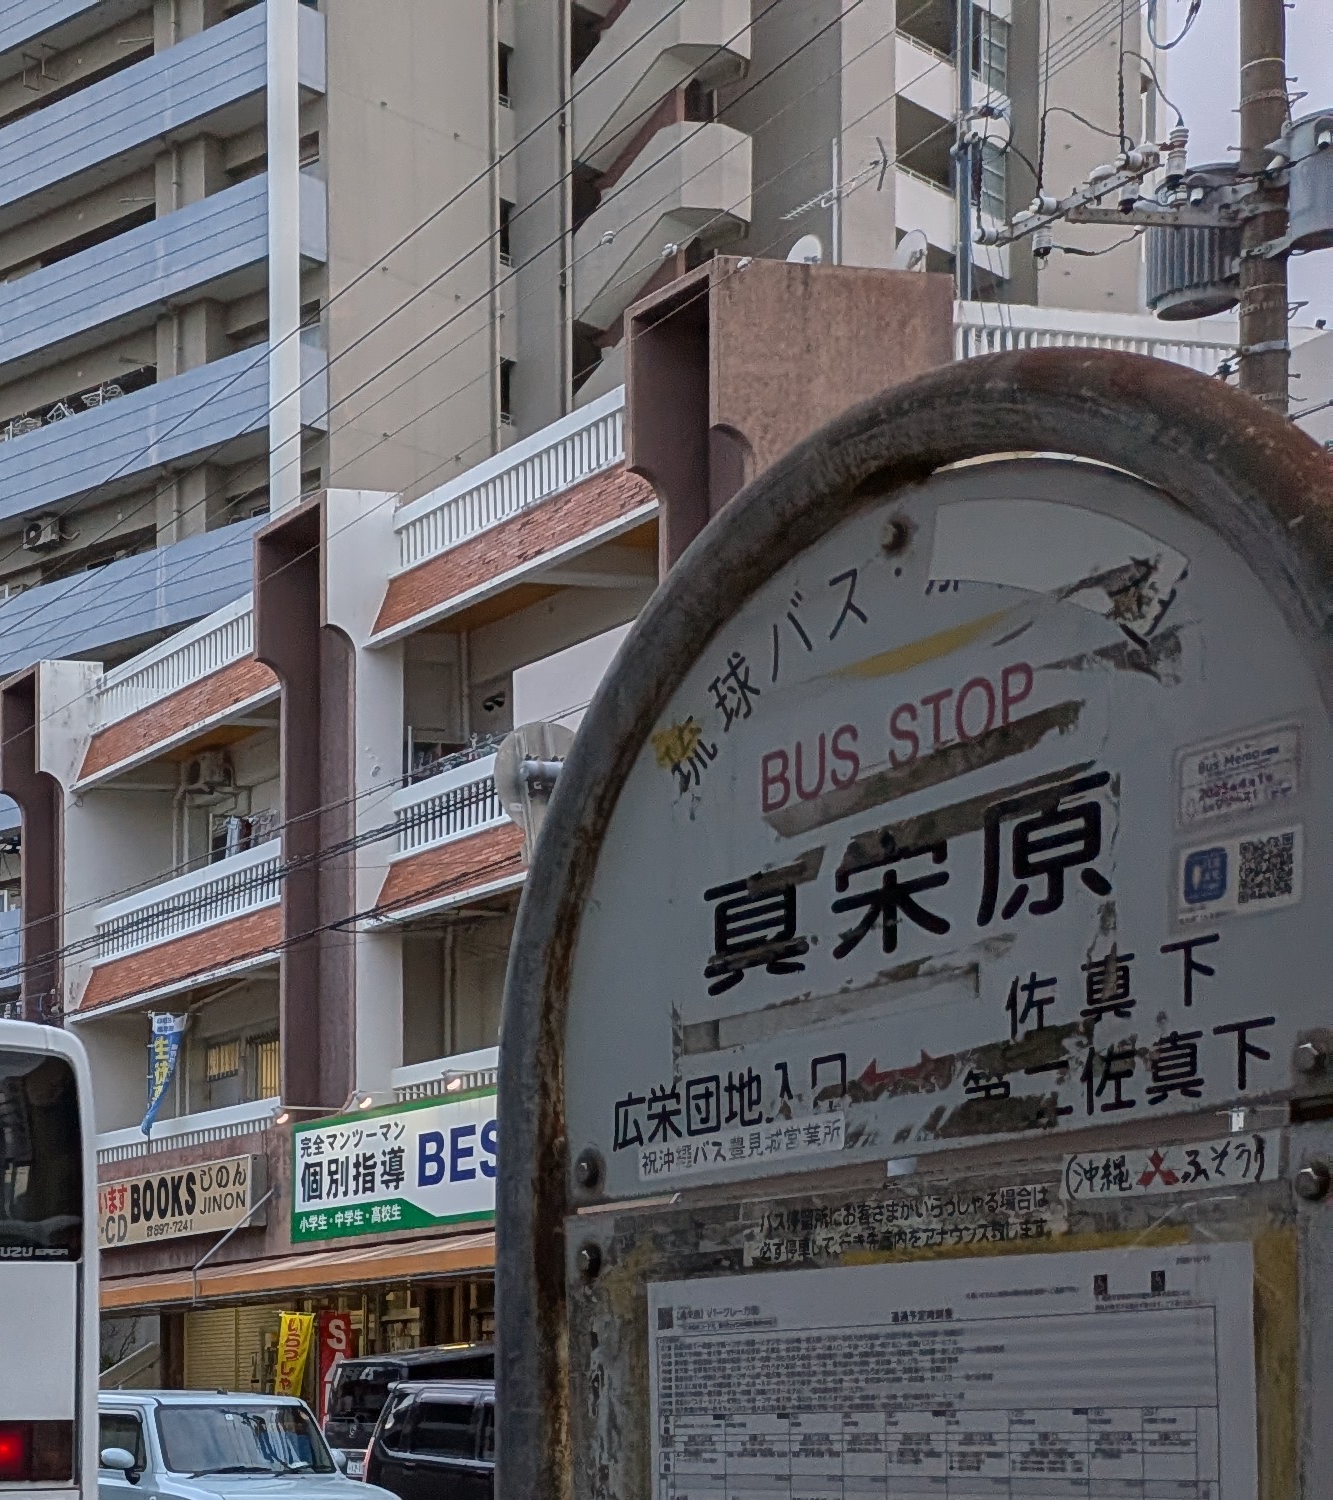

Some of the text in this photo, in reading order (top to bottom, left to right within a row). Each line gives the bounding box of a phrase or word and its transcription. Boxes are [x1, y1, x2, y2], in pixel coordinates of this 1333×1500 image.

[761, 661, 1036, 814] BUS STOP
[703, 769, 1113, 996] 真栄原
[1005, 932, 1221, 1043] 佐真下
[612, 1052, 847, 1152] 広栄団地入口
[300, 1120, 406, 1160] 完全マンツーマン
[300, 1145, 407, 1203] 個別指導
[130, 1170, 197, 1225] BOOKS
[199, 1189, 247, 1215] JINON
[299, 1203, 403, 1233] 小学生・中学生・高校生
[277, 1317, 303, 1396] いらっしゃ
